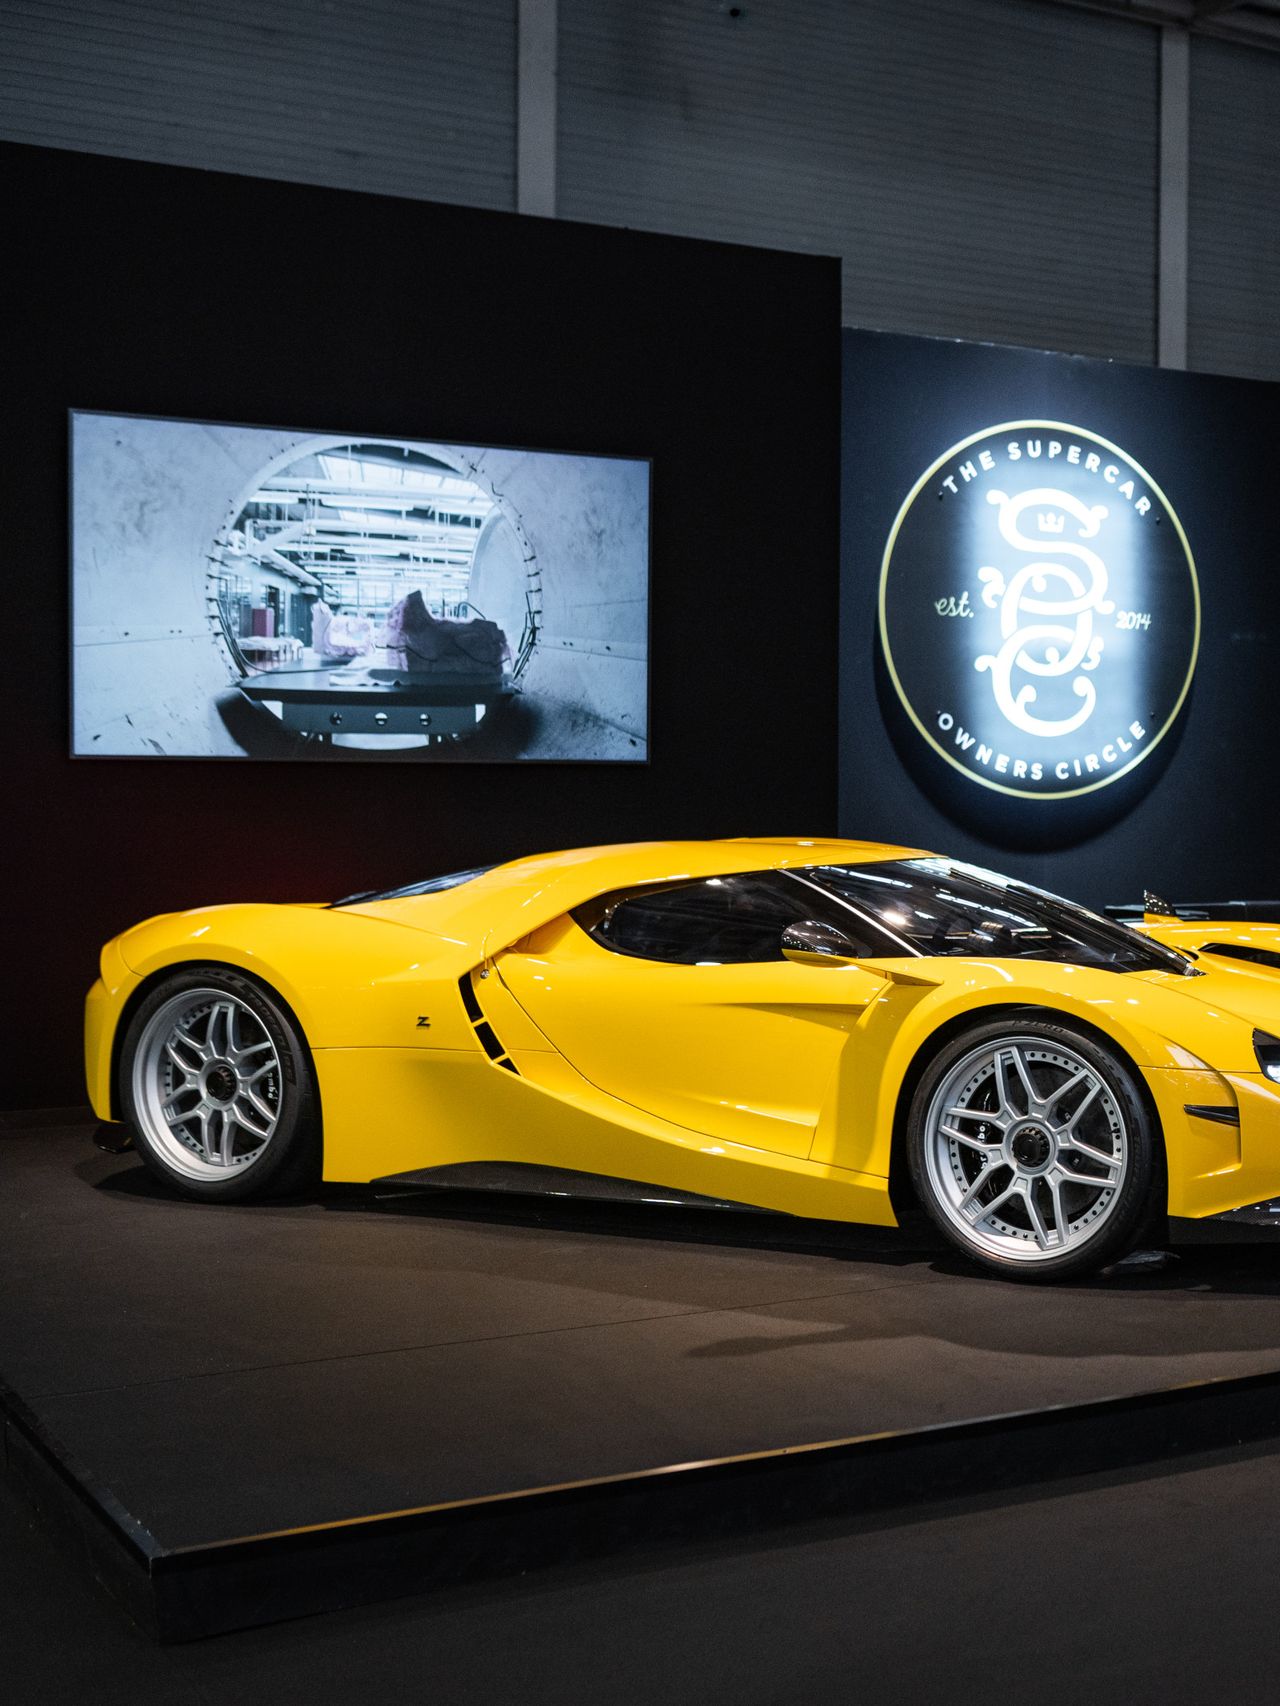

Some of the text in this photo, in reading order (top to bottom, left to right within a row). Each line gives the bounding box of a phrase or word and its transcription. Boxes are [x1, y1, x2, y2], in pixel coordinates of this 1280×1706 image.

[942, 439, 1151, 516] THE SUPERCAR
[934, 591, 1152, 631] est. 2014
[937, 712, 1146, 781] OWNERS CIRCLE
